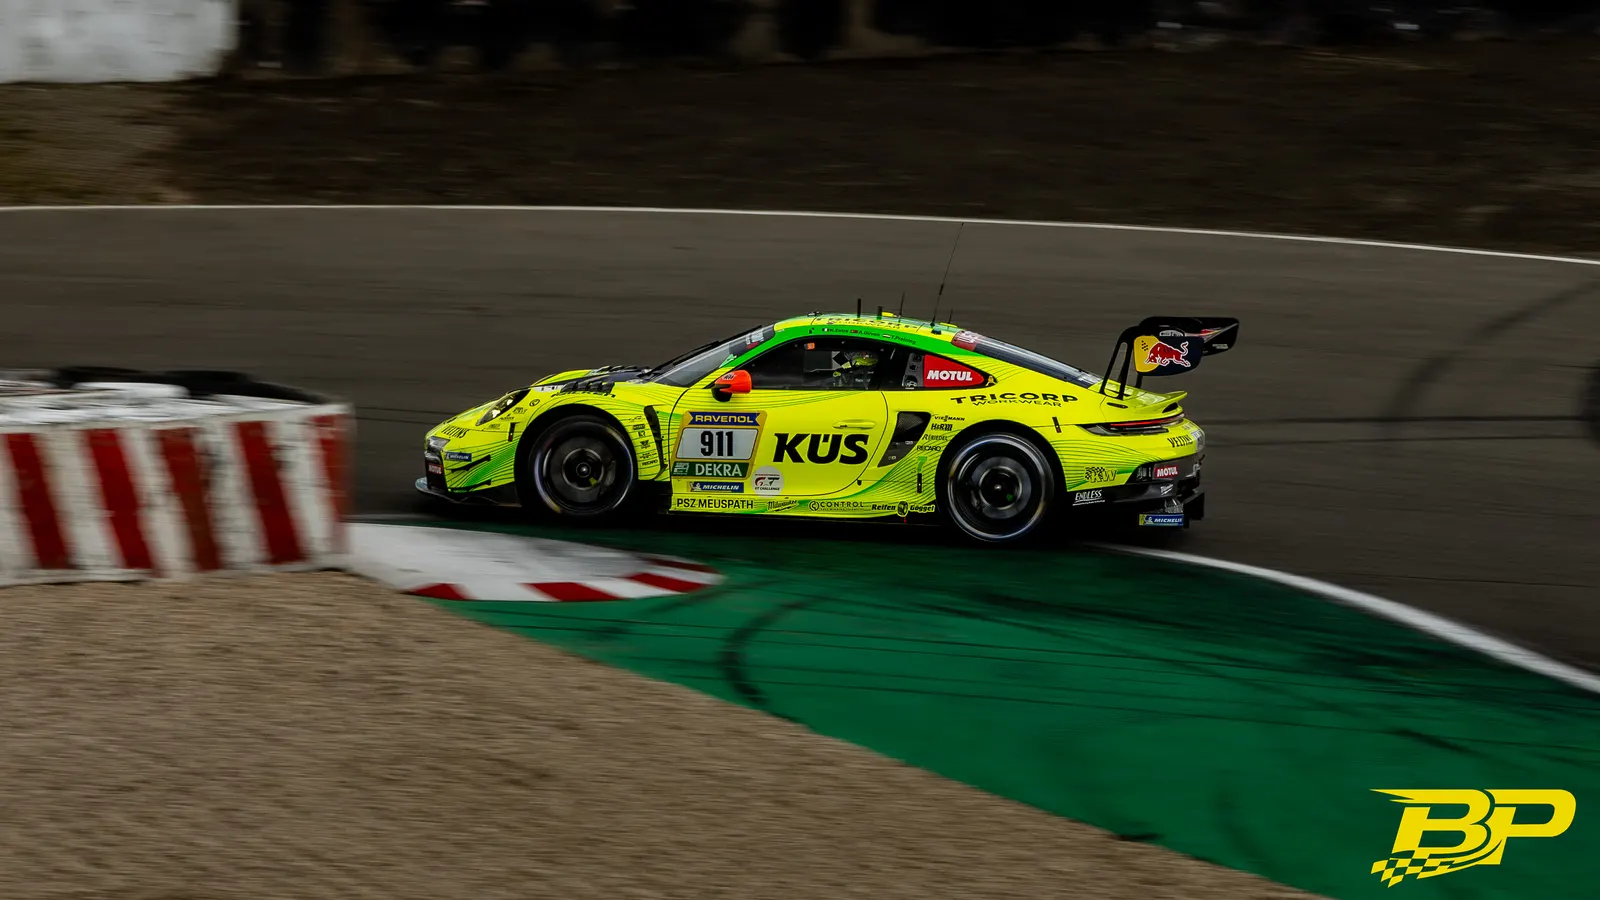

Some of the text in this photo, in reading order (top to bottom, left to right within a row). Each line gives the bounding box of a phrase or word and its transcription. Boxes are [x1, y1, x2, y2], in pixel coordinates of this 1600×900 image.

[926, 370, 973, 381] MOTUL
[950, 392, 1078, 404] TRICORP
[973, 400, 1062, 408] WORKWEAR
[695, 414, 754, 423] RAVENOL
[700, 430, 734, 457] 911
[772, 433, 870, 464] KÜS
[695, 463, 743, 477] DEKRA
[1090, 468, 1117, 483] KW
[1156, 466, 1178, 477] MOTUL
[1074, 489, 1103, 501] ENDLESS
[676, 498, 754, 509] PSZ MEUSPATH
